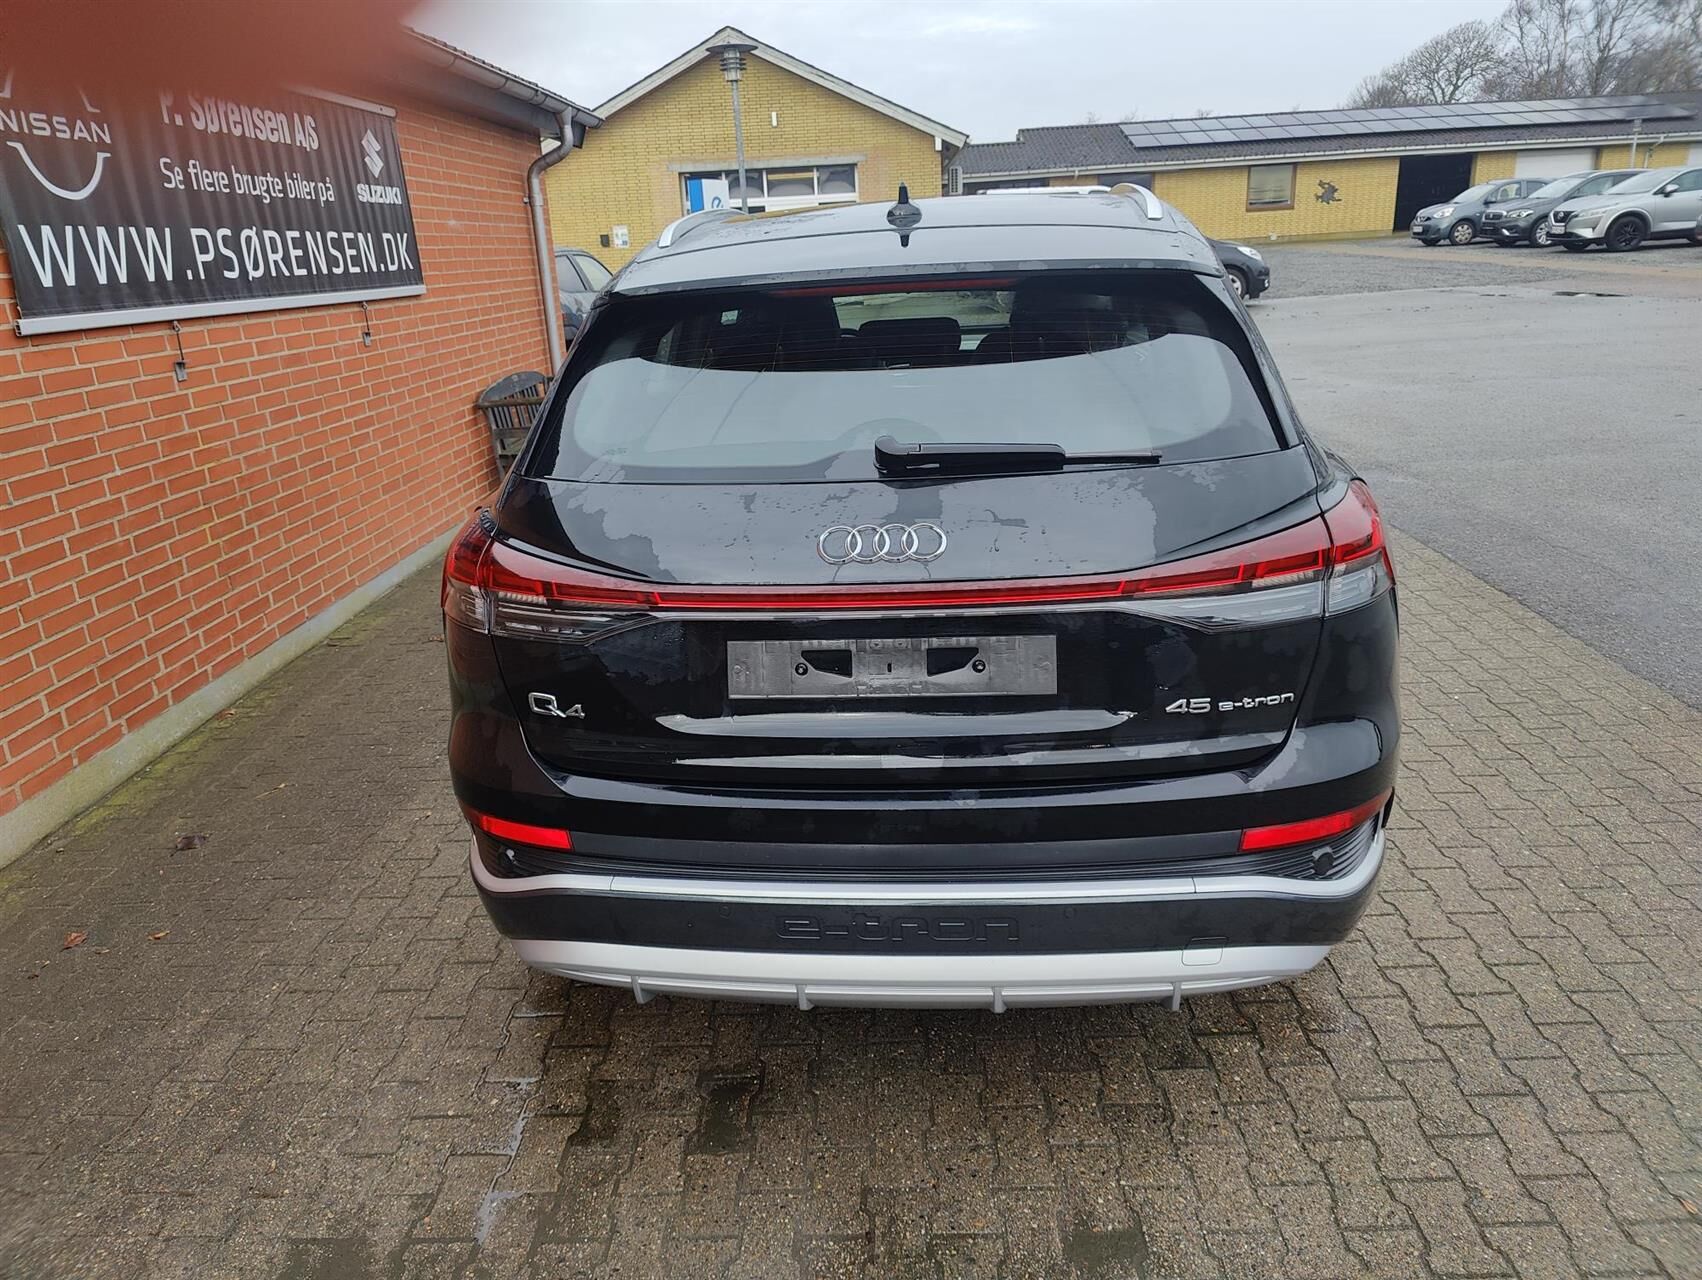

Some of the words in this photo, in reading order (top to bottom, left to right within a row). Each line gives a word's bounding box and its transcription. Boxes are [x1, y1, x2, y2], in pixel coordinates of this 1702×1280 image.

[0, 108, 112, 144] NISSAN
[189, 93, 291, 145] Sørensen
[294, 112, 319, 151] A/S
[159, 157, 185, 189] Se
[188, 159, 230, 193] flere
[231, 165, 283, 203] brugte
[284, 171, 316, 200] biler
[317, 176, 335, 207] på
[356, 183, 402, 205] SUZUKI
[528, 692, 585, 719] Q4
[1165, 697, 1211, 714] 45
[1218, 692, 1295, 711] e-tron
[776, 912, 1019, 942] e-tron
